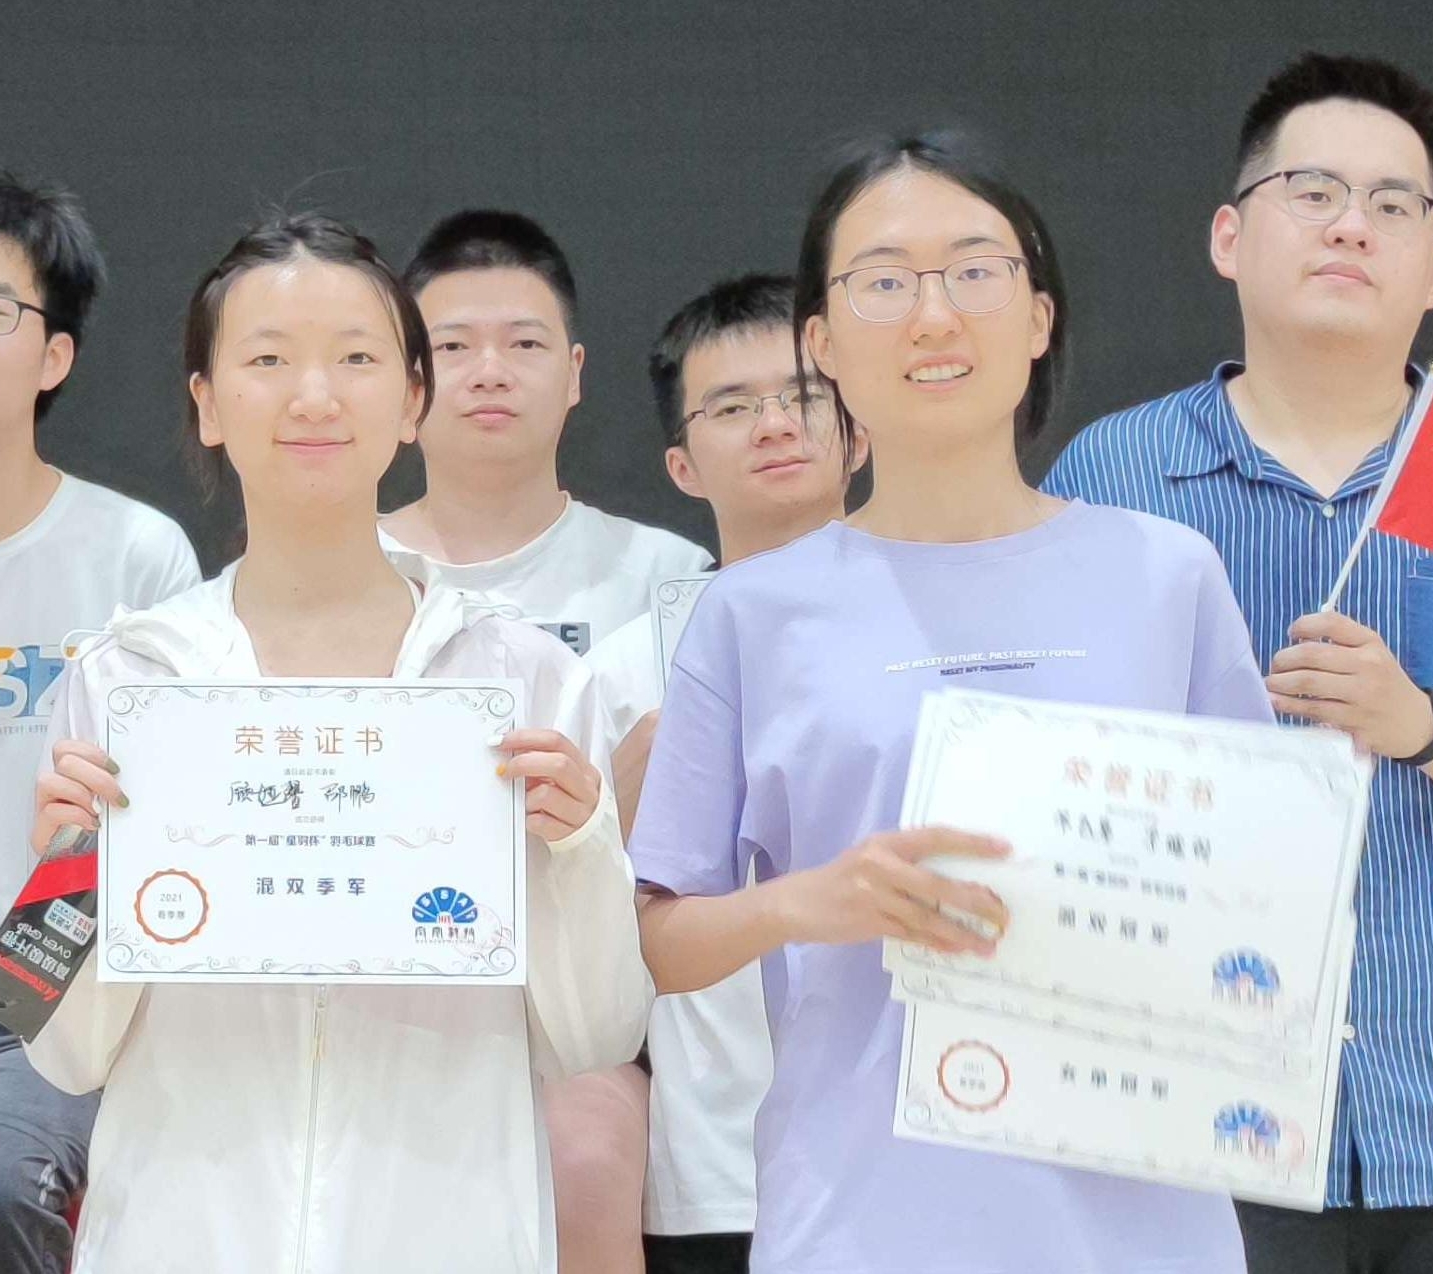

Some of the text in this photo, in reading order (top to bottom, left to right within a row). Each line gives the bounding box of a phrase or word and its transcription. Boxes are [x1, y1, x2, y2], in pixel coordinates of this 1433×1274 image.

[234, 725, 383, 756] 荣誉证书
[159, 892, 183, 902] 2021
[255, 876, 367, 897] 混双季军
